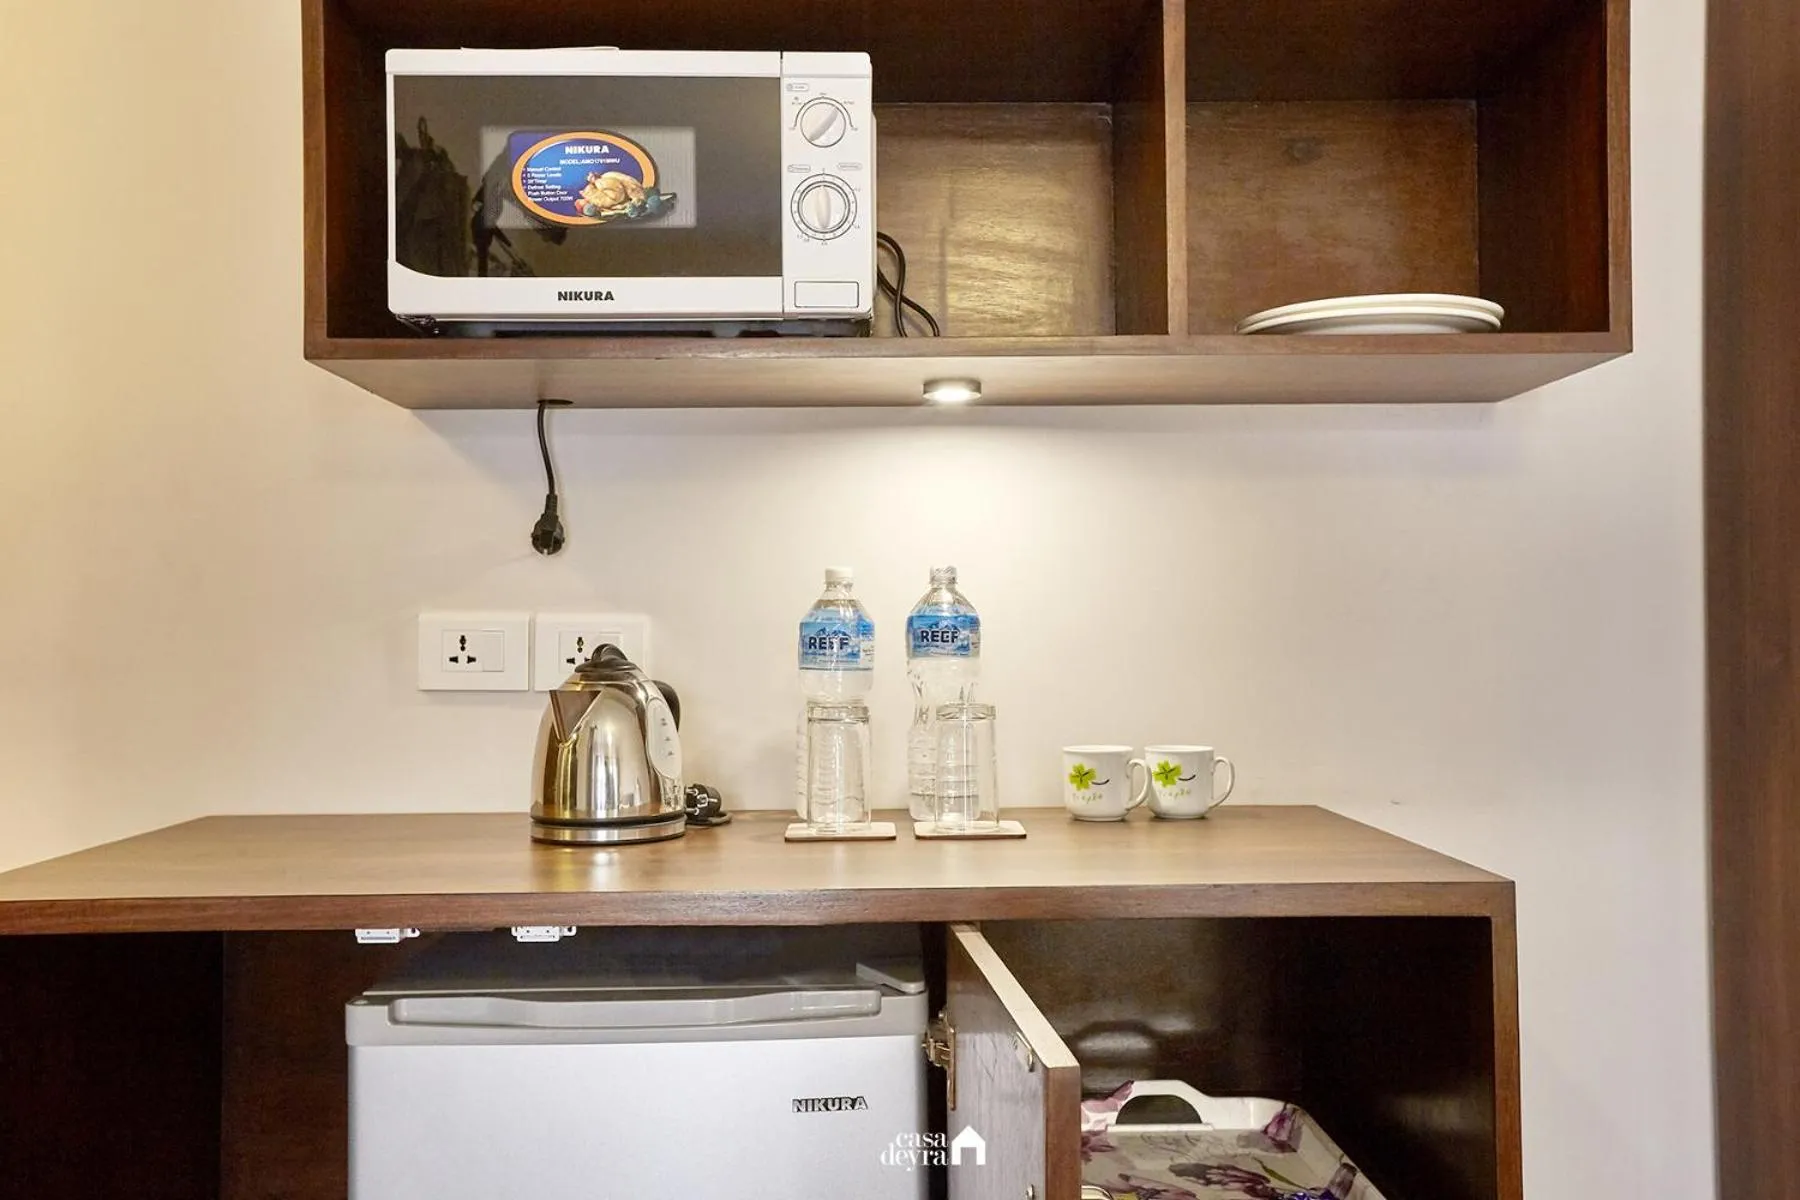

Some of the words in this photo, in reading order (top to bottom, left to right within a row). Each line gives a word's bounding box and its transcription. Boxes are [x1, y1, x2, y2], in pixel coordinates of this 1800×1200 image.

[565, 145, 609, 154] NIKURA
[557, 290, 615, 301] NIKURA
[921, 629, 959, 644] REEF
[792, 1096, 868, 1113] NIKURA
